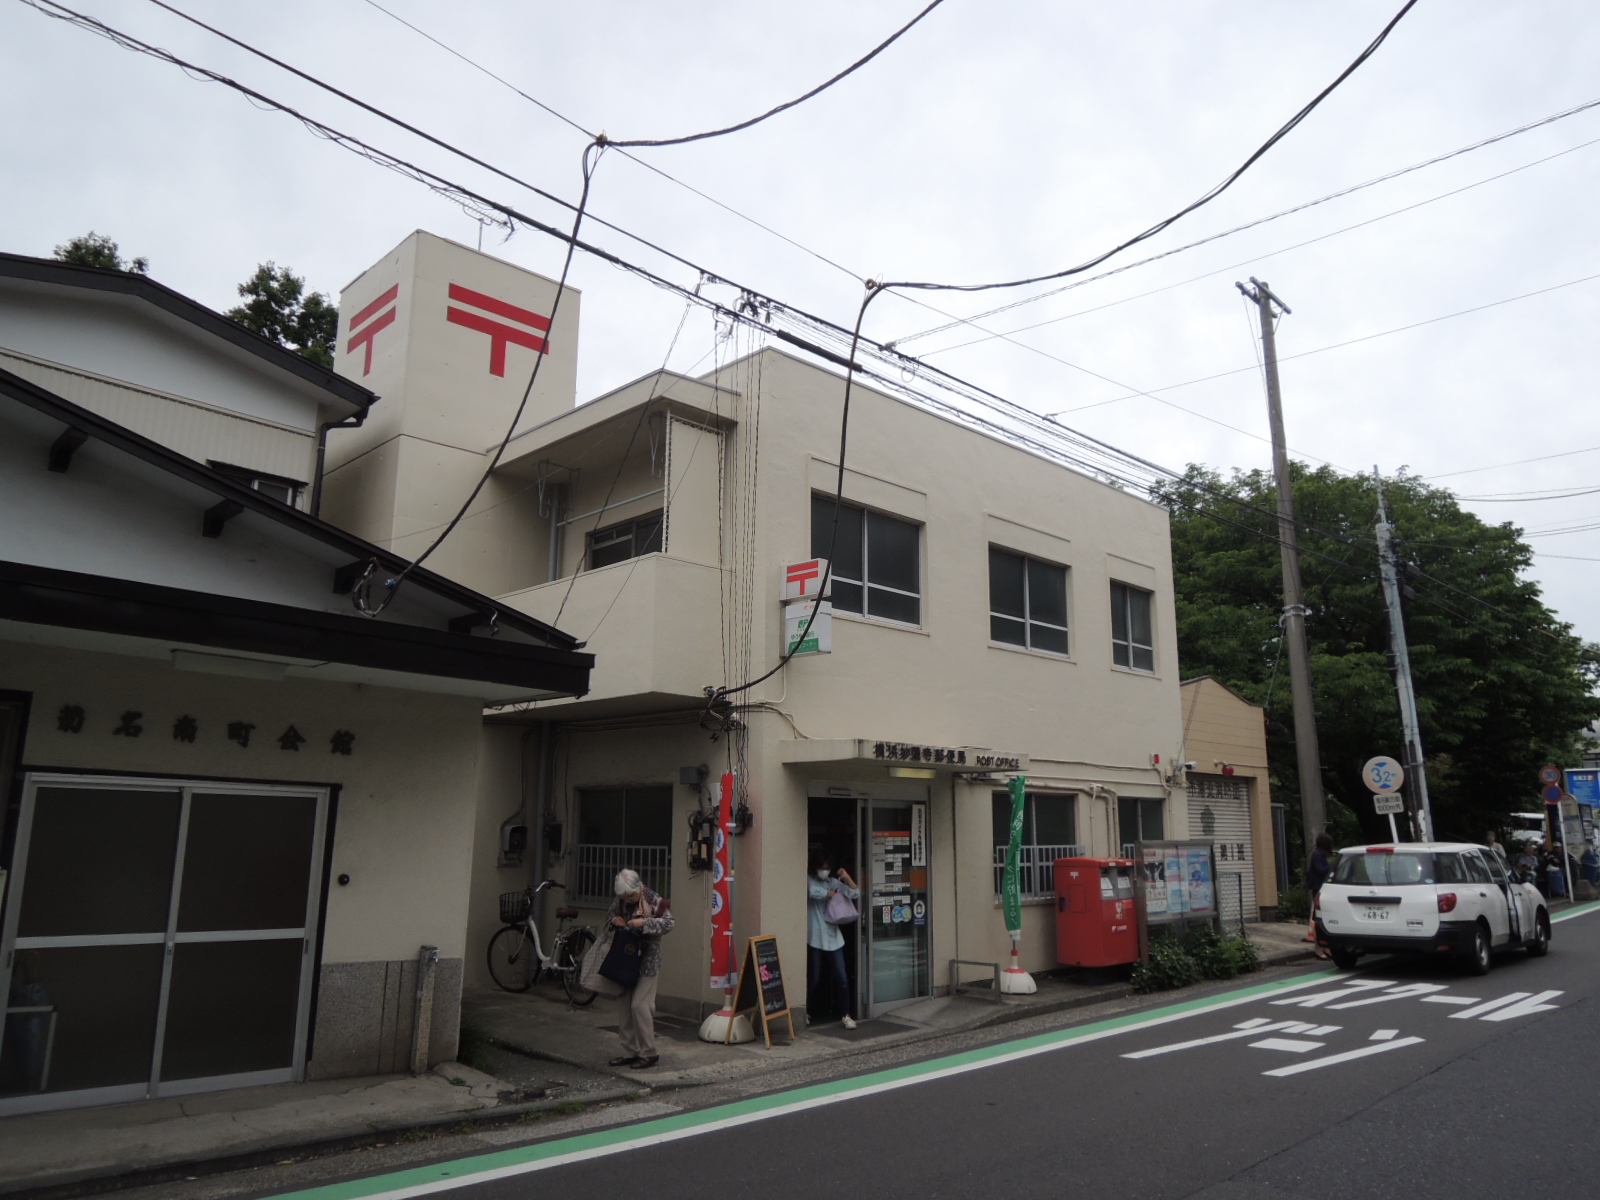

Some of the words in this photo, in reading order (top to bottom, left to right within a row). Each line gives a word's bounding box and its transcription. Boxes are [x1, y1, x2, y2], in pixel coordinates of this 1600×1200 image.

[56, 703, 357, 756] 菊名南町会館
[873, 742, 967, 765] 横浜妙蓮寺郵便局
[976, 755, 994, 767] POST
[995, 756, 1020, 769] OFFICE
[1544, 770, 1557, 780] 30
[1269, 979, 1565, 1022] スクール
[1119, 1018, 1427, 1077] ゾーン
